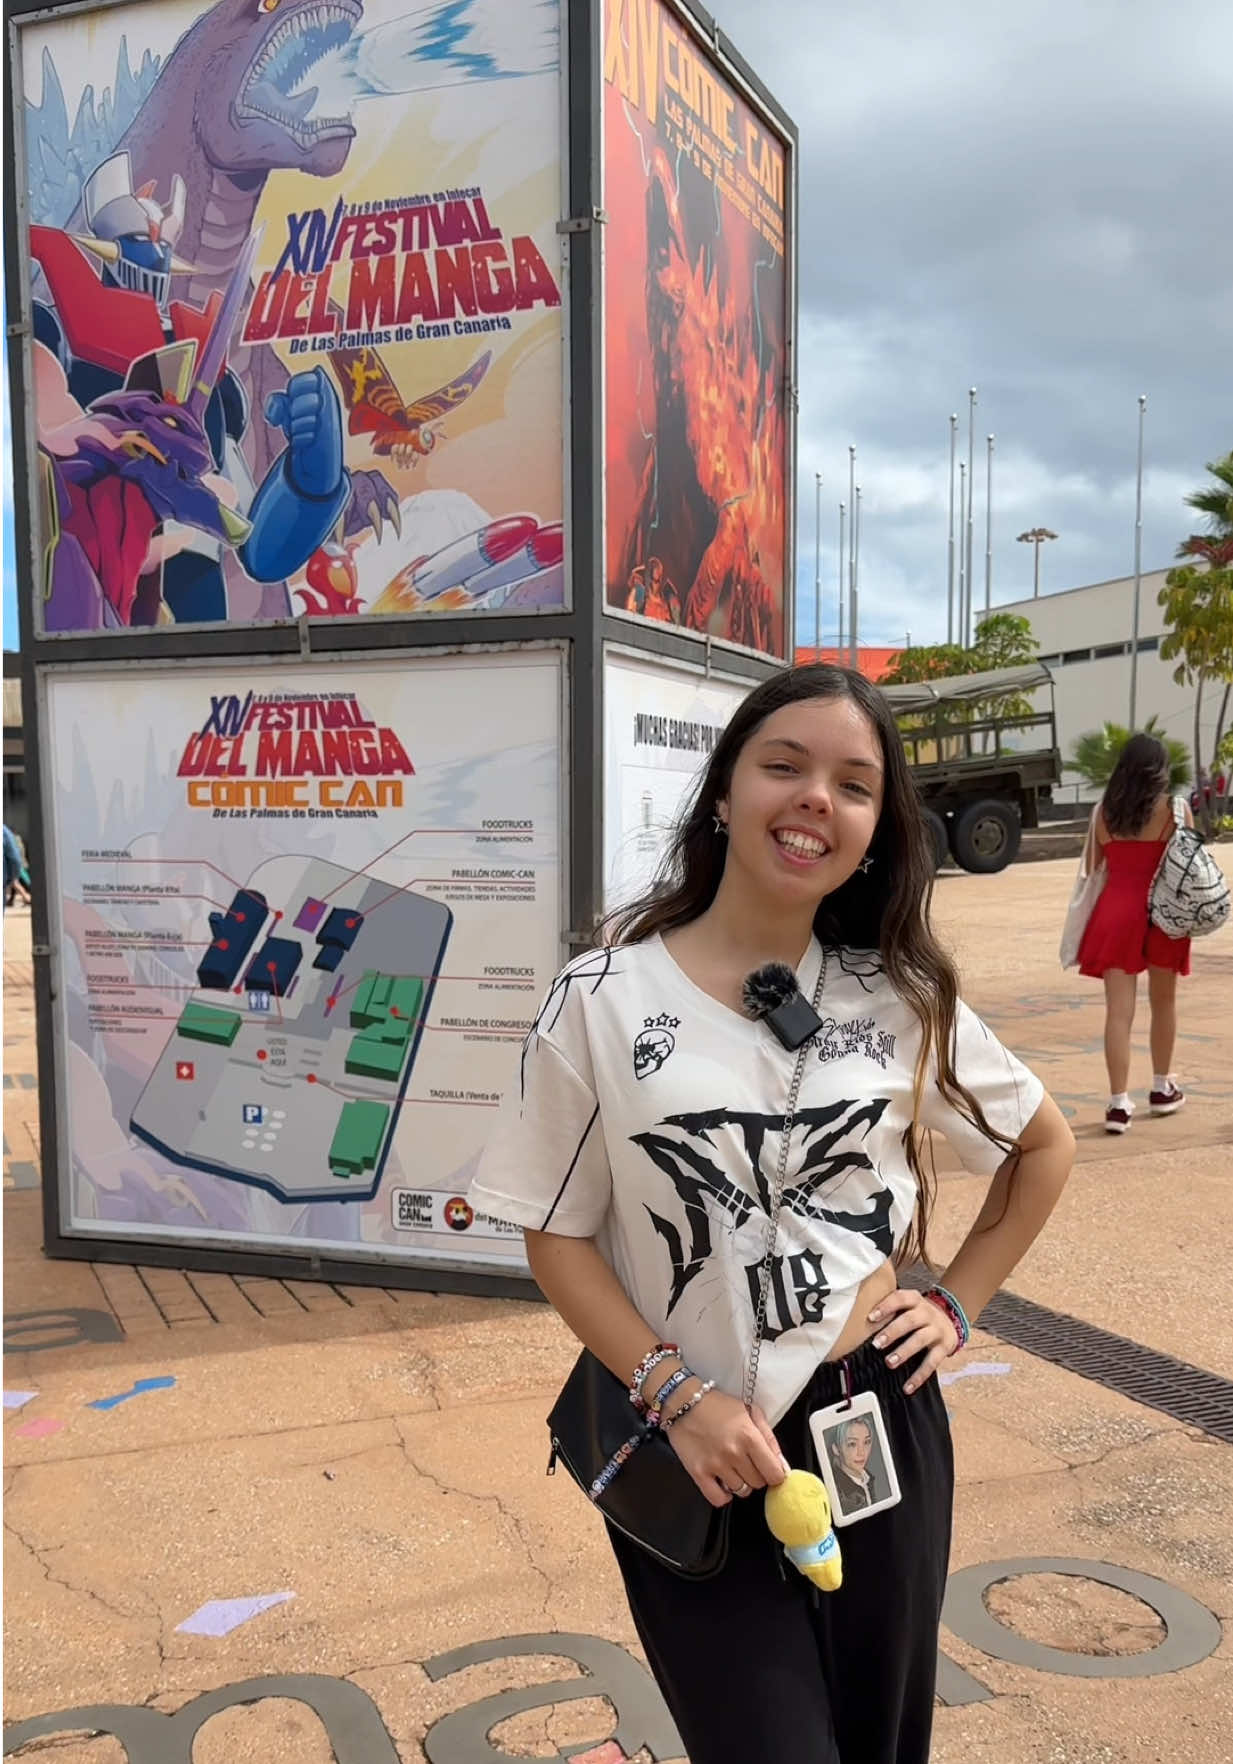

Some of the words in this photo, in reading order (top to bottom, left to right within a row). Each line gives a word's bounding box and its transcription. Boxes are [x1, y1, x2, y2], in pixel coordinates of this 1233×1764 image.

[745, 120, 784, 209] CAN
[384, 193, 431, 209] Noviembre
[269, 193, 343, 285] XIV
[330, 197, 503, 262] FESTIVAL
[242, 265, 338, 342] DEL
[346, 236, 561, 332] MANGA
[289, 338, 308, 354] De
[311, 335, 335, 351] Las
[338, 330, 391, 348] Palmas
[395, 326, 412, 342] de
[416, 322, 451, 338] Gran
[454, 316, 511, 336] Canaria
[198, 690, 252, 741] XIV
[243, 700, 376, 731] FESTIVAL
[177, 732, 250, 777] DEL
[255, 728, 416, 779] MANGA
[319, 780, 403, 807] CAN
[212, 808, 228, 818] De
[230, 808, 248, 818] Las
[250, 808, 289, 819] Palmas
[292, 808, 305, 818] de
[308, 808, 333, 818] Gran
[335, 808, 378, 819] Canaria
[482, 820, 533, 829] FOODTRUCKS
[452, 869, 489, 878] PABELLÓN
[484, 967, 535, 977] FOODTRUCKS
[440, 1017, 479, 1027] PABELLÓN
[480, 1019, 489, 1028] DE
[430, 1089, 464, 1099] TAQUILLA
[399, 1193, 432, 1209] COMIC
[399, 1207, 421, 1221] CAN
